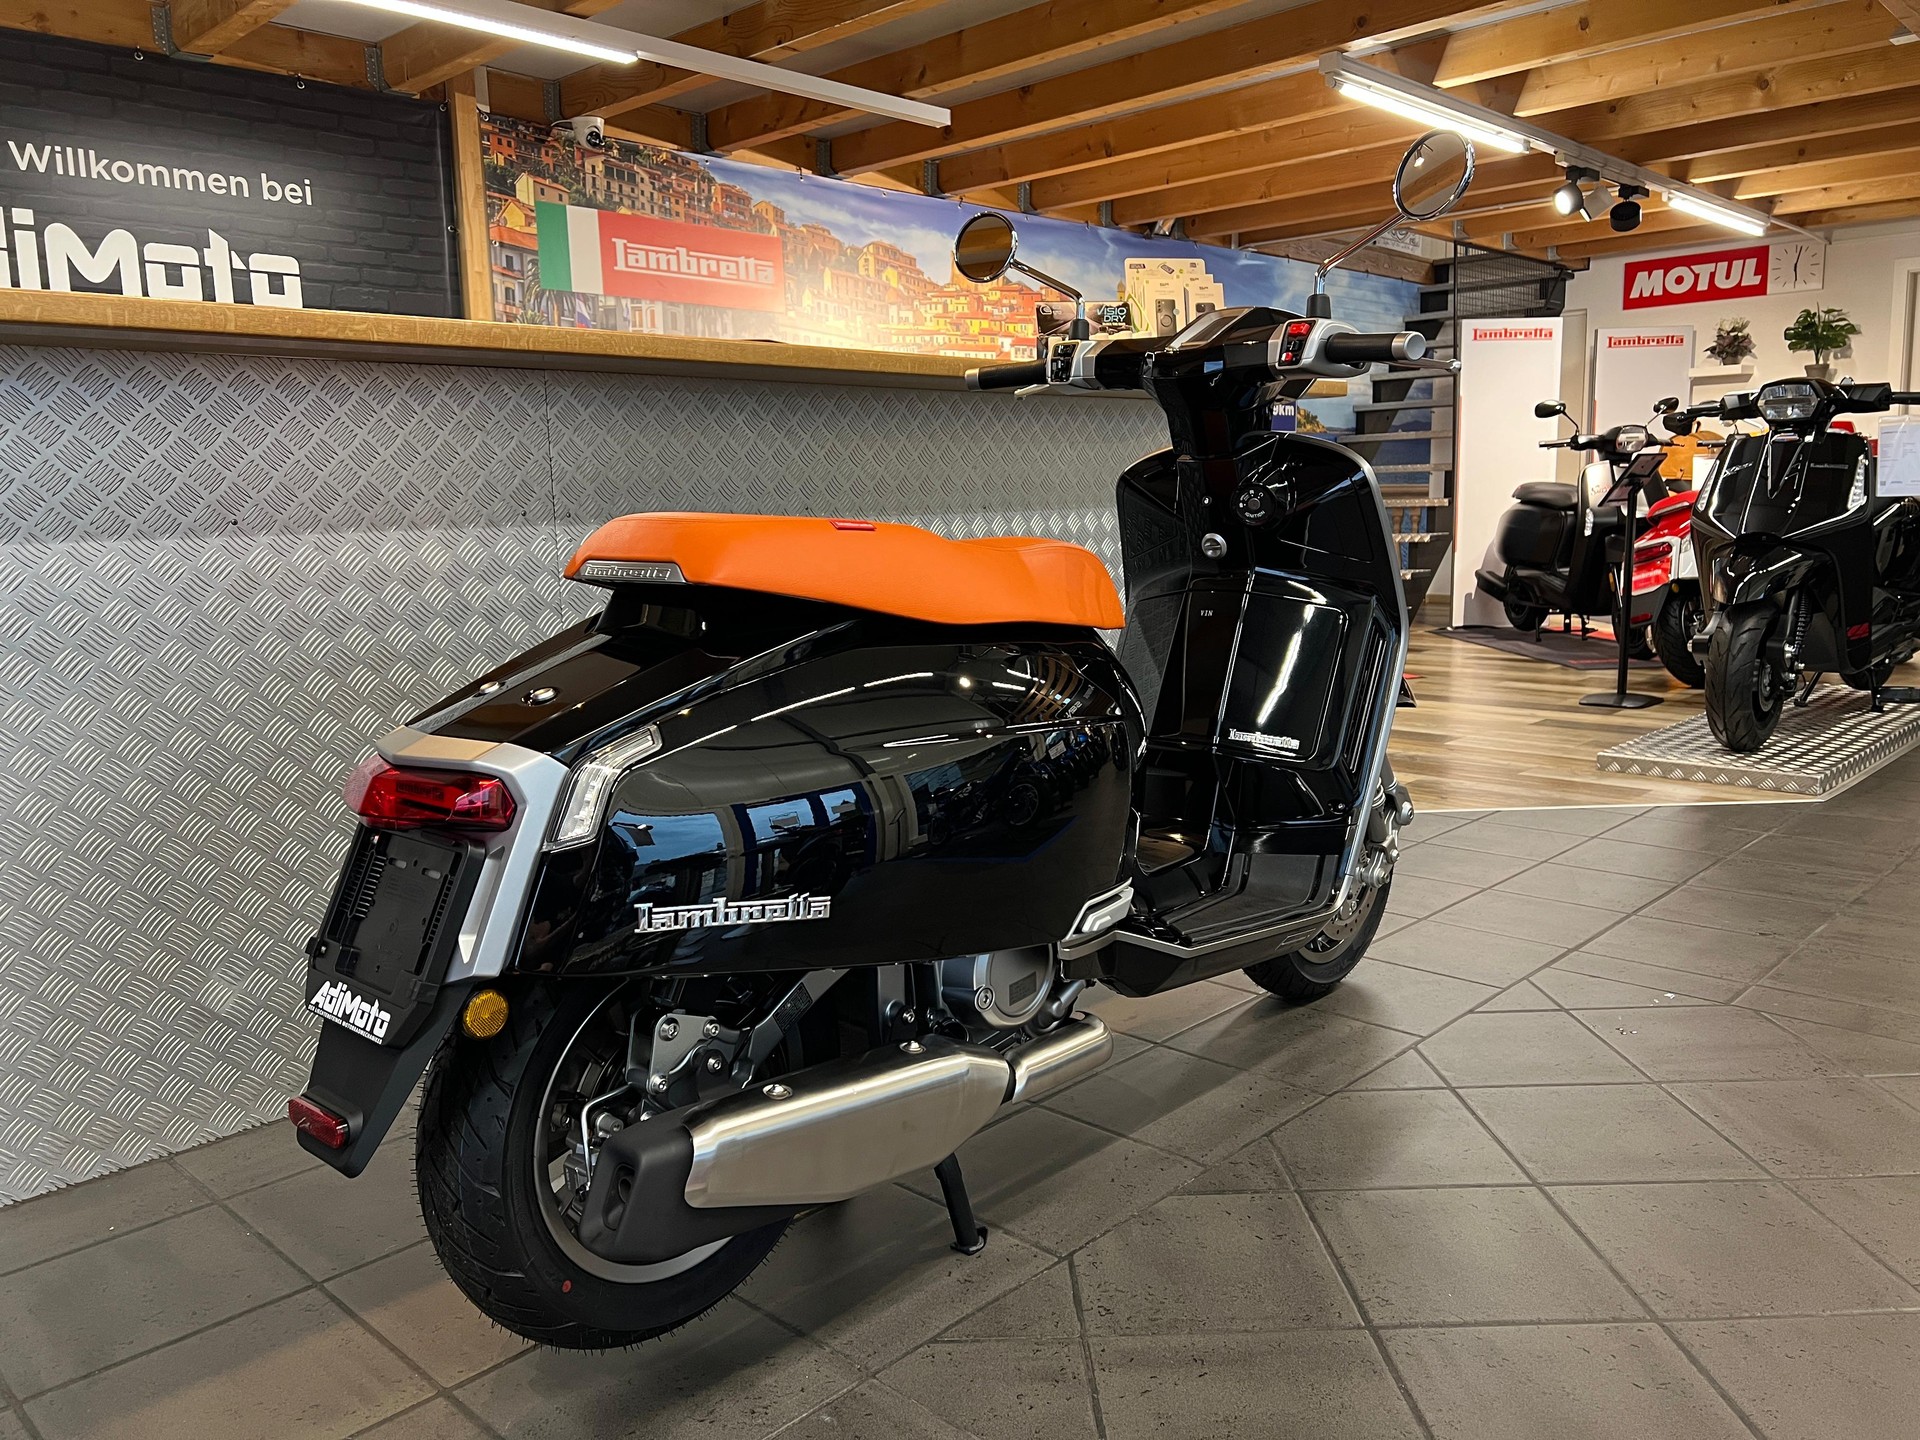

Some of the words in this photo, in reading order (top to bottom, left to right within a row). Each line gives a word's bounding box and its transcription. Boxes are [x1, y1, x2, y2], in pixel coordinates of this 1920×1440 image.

[8, 140, 249, 198] Willkommen
[261, 173, 313, 206] bei
[0, 206, 304, 309] iMoto
[612, 237, 775, 289] Lambretta
[1629, 257, 1762, 299] MOTUL
[1096, 304, 1127, 316] VISIO
[1472, 327, 1553, 342] Lambretta
[1607, 334, 1685, 348] Lambretta
[634, 892, 831, 933] Lambretta
[310, 980, 391, 1038] AdiMoto
